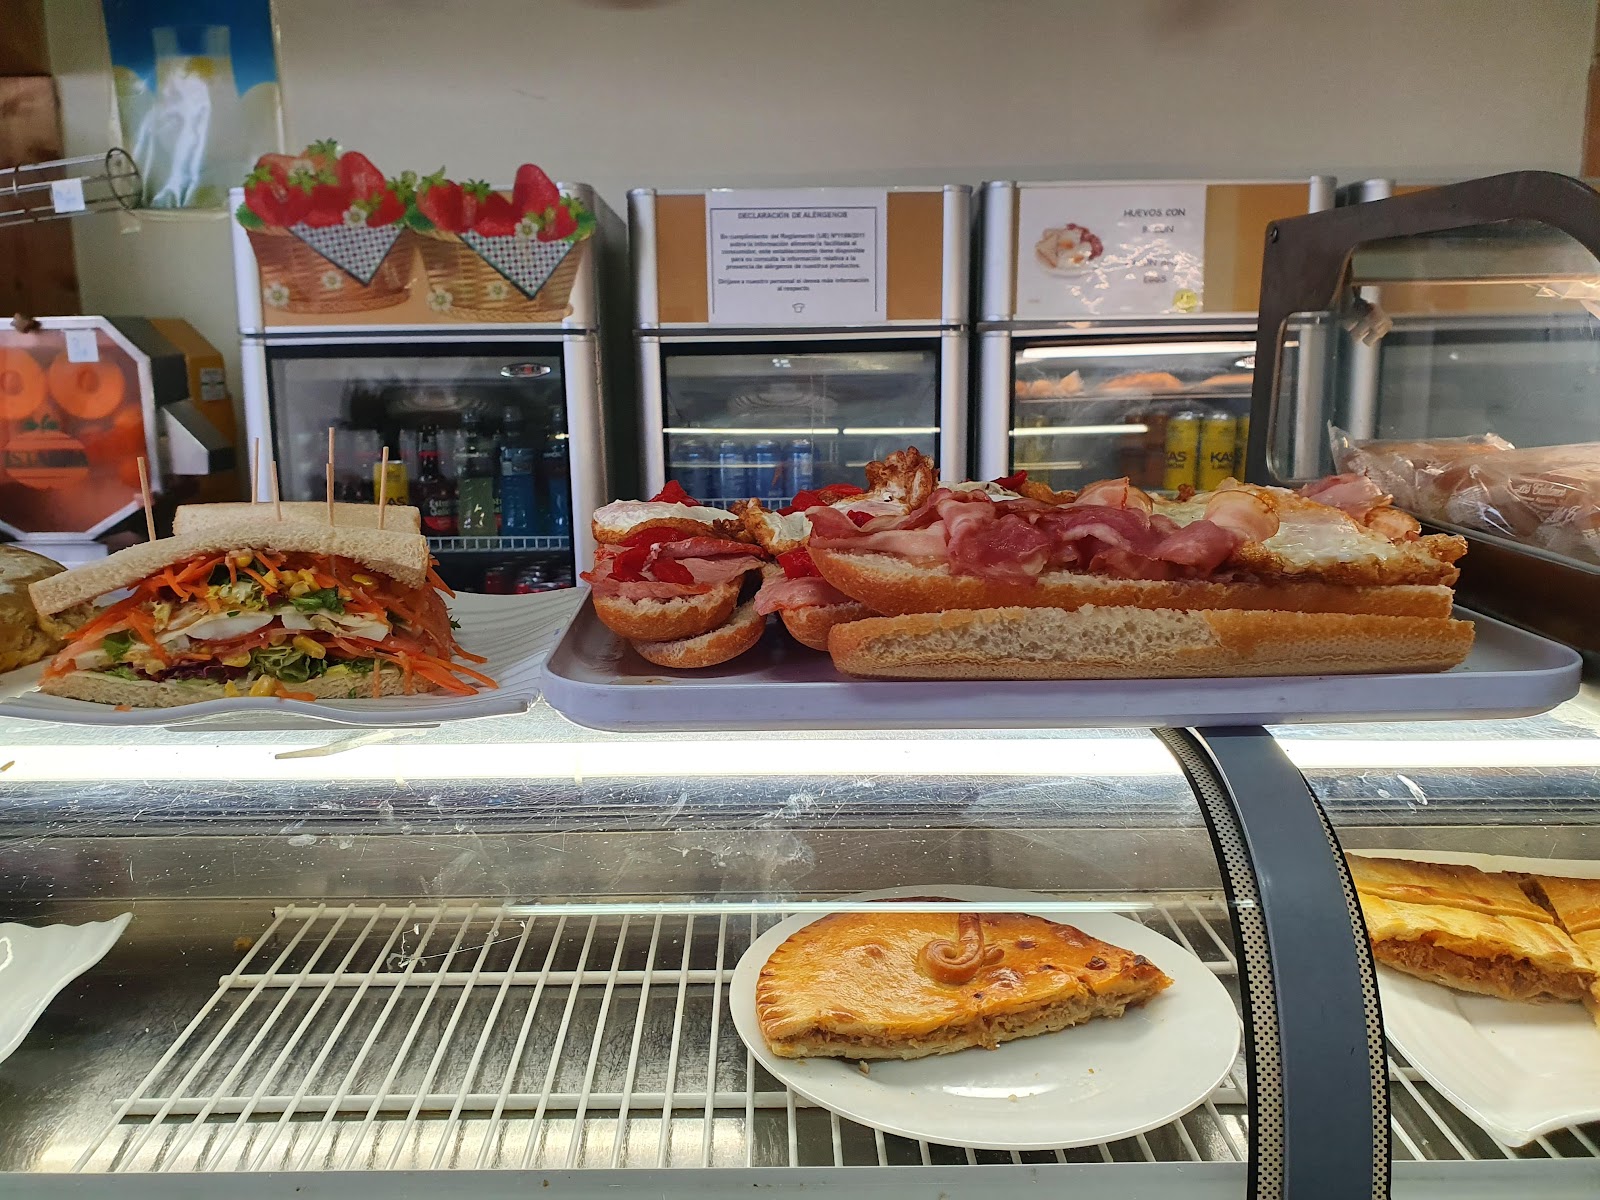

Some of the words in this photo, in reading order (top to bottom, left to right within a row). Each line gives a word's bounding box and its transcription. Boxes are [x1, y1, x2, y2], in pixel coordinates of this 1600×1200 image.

[791, 211, 801, 219] DE
[1124, 208, 1162, 217] HUEVOS
[1166, 207, 1186, 217] CON
